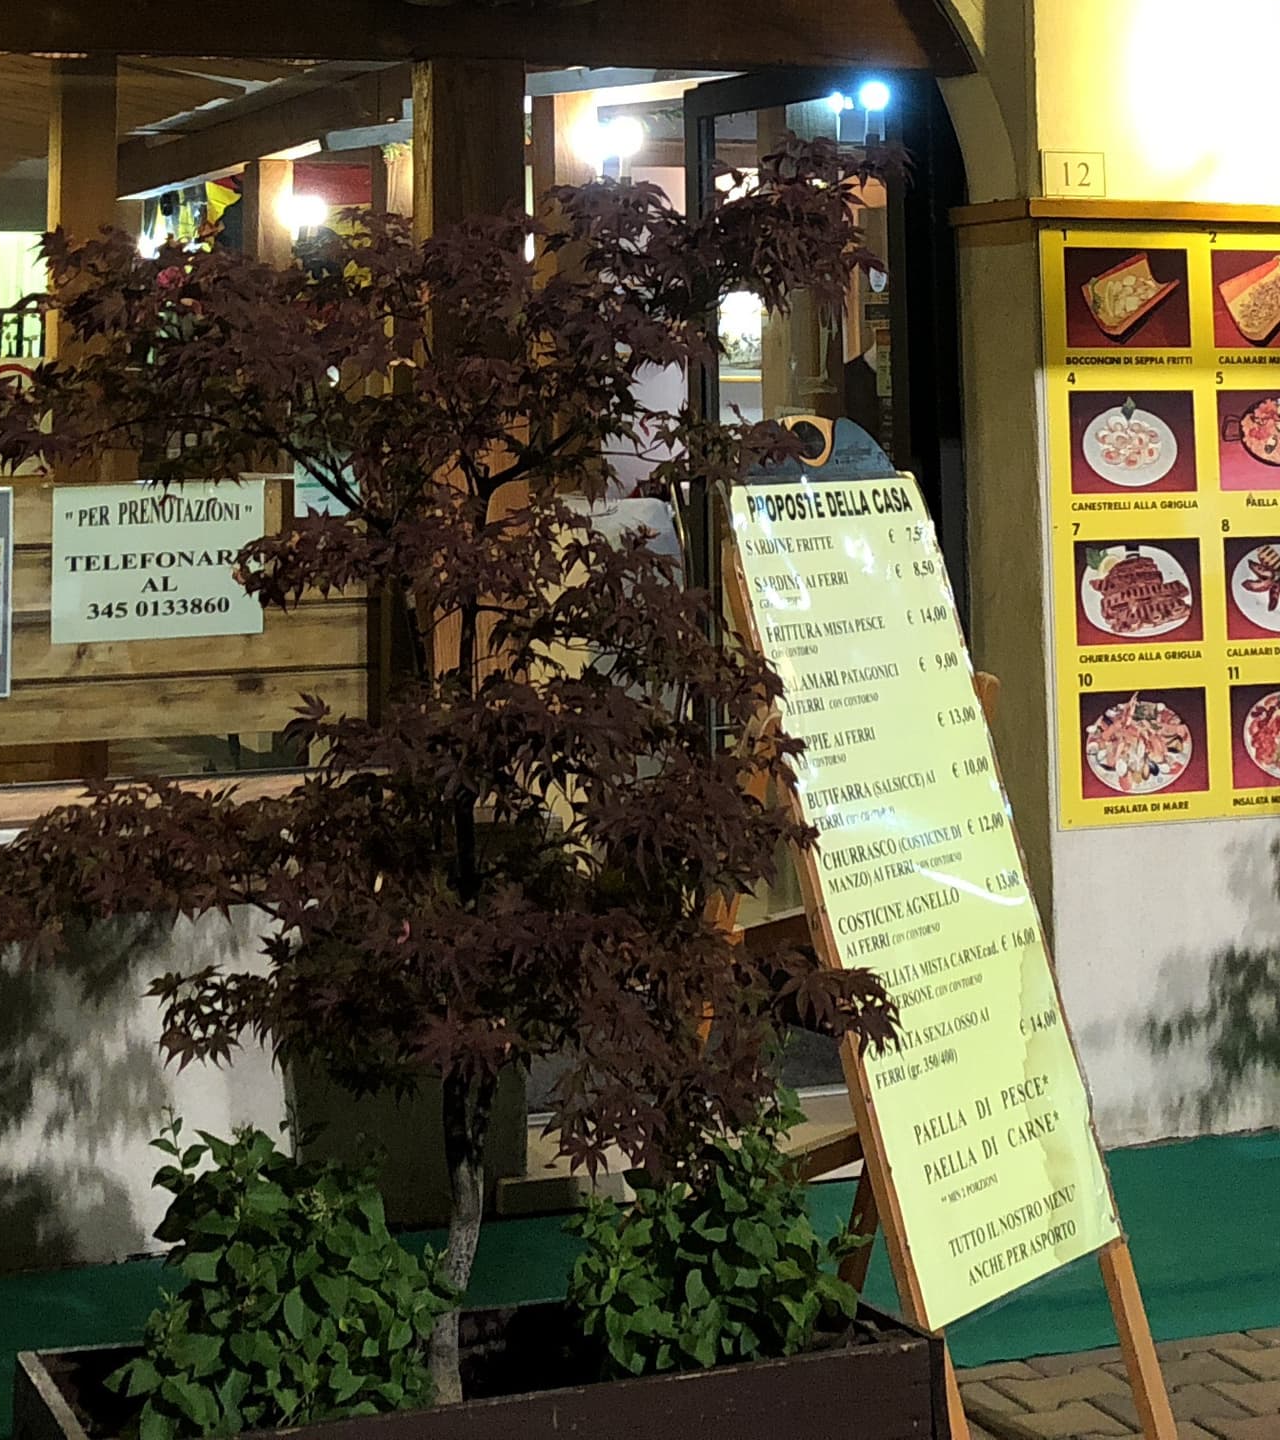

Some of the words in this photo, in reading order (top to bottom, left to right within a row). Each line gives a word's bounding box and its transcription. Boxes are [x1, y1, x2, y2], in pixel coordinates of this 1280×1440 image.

[1063, 161, 1091, 187] 12
[1061, 228, 1068, 242] 1
[1208, 231, 1217, 243] 2
[1123, 355, 1133, 365] DI
[1134, 355, 1163, 365] SEPPIA
[1166, 355, 1193, 365] FRITTI
[1218, 355, 1268, 365] CALAMARI
[1066, 372, 1077, 385] 4
[1215, 371, 1224, 384] 5
[77, 504, 110, 528] PER
[118, 495, 241, 527] PRENOTAZIONI
[825, 488, 871, 518] DELLA
[872, 486, 913, 514] CASA
[1071, 501, 1131, 511] CANESTRELLI
[1133, 500, 1158, 510] ALLA
[1160, 499, 1199, 510] GRIGLIA
[1246, 496, 1278, 507] PAELLA
[1071, 522, 1081, 537] 7
[1221, 518, 1230, 533] 8
[745, 537, 793, 556] SARDINE
[796, 535, 834, 554] FRITTE
[140, 575, 178, 594] AL
[806, 573, 819, 590] AI
[819, 571, 849, 588] FERRI
[894, 563, 902, 579] €
[912, 559, 935, 578] 8,50
[86, 600, 129, 621] 345
[135, 596, 231, 618] 0133860
[765, 622, 823, 643] FRITTURA
[824, 619, 855, 637] MISTA
[855, 615, 886, 633] PESCE
[906, 609, 915, 625] €
[919, 605, 948, 624] 14,00
[1138, 651, 1162, 662] ALLA
[1164, 649, 1202, 661] GRIGLIA
[1226, 646, 1273, 657] CALAMARI
[841, 662, 900, 686] PATAGONICI
[918, 656, 927, 672] €
[935, 651, 959, 672] 9,00
[1078, 672, 1093, 687] 10
[1228, 665, 1240, 680] 11
[785, 700, 796, 717] AI
[796, 696, 826, 716] FERRI
[834, 732, 846, 748] AI
[846, 726, 877, 746] FERRI
[937, 710, 946, 728] €
[949, 705, 977, 726] 13,00
[806, 783, 871, 811] BUTIFARRA
[872, 772, 926, 800] (SALSICCE)
[925, 769, 937, 786] AI
[951, 761, 960, 779] €
[963, 755, 990, 777] 10,00
[1103, 802, 1148, 815] INSALATA
[1151, 802, 1161, 812] DI
[1162, 800, 1190, 811] MARE
[1232, 795, 1269, 807] INSALATA
[812, 813, 846, 833] FERRI
[822, 838, 898, 873] CHURRASCO
[951, 824, 963, 842] DI
[967, 818, 976, 836] €
[978, 811, 1005, 834] 12,00
[827, 871, 873, 896] MANZO)
[873, 867, 885, 885] AI
[884, 859, 916, 881] FERRI
[837, 901, 906, 936] COSTICINE
[905, 886, 961, 918] AGNELLO
[845, 941, 858, 959] AI
[858, 932, 891, 957] FERRI
[919, 956, 951, 978] MISTA
[1001, 934, 1009, 952] €
[1011, 926, 1036, 949] 16,00
[922, 1020, 956, 1045] SENZA
[954, 1010, 980, 1034] OSSO
[978, 1006, 991, 1024] AI
[1030, 1009, 1058, 1033] 14,00
[874, 1064, 907, 1091] FERRI
[912, 1108, 968, 1146] PAELLA
[975, 1095, 993, 1121] DI
[923, 1146, 979, 1186] PAELLA
[981, 1135, 1000, 1161] DI
[966, 1173, 1000, 1195] PORZIONI
[947, 1224, 987, 1259] TUTTO
[985, 1221, 1000, 1241] IL
[998, 1199, 1044, 1235] NOSTRO
[968, 1251, 1007, 1287] ANCHE
[1005, 1241, 1029, 1267] PER
[1028, 1218, 1078, 1256] ASPORTO
